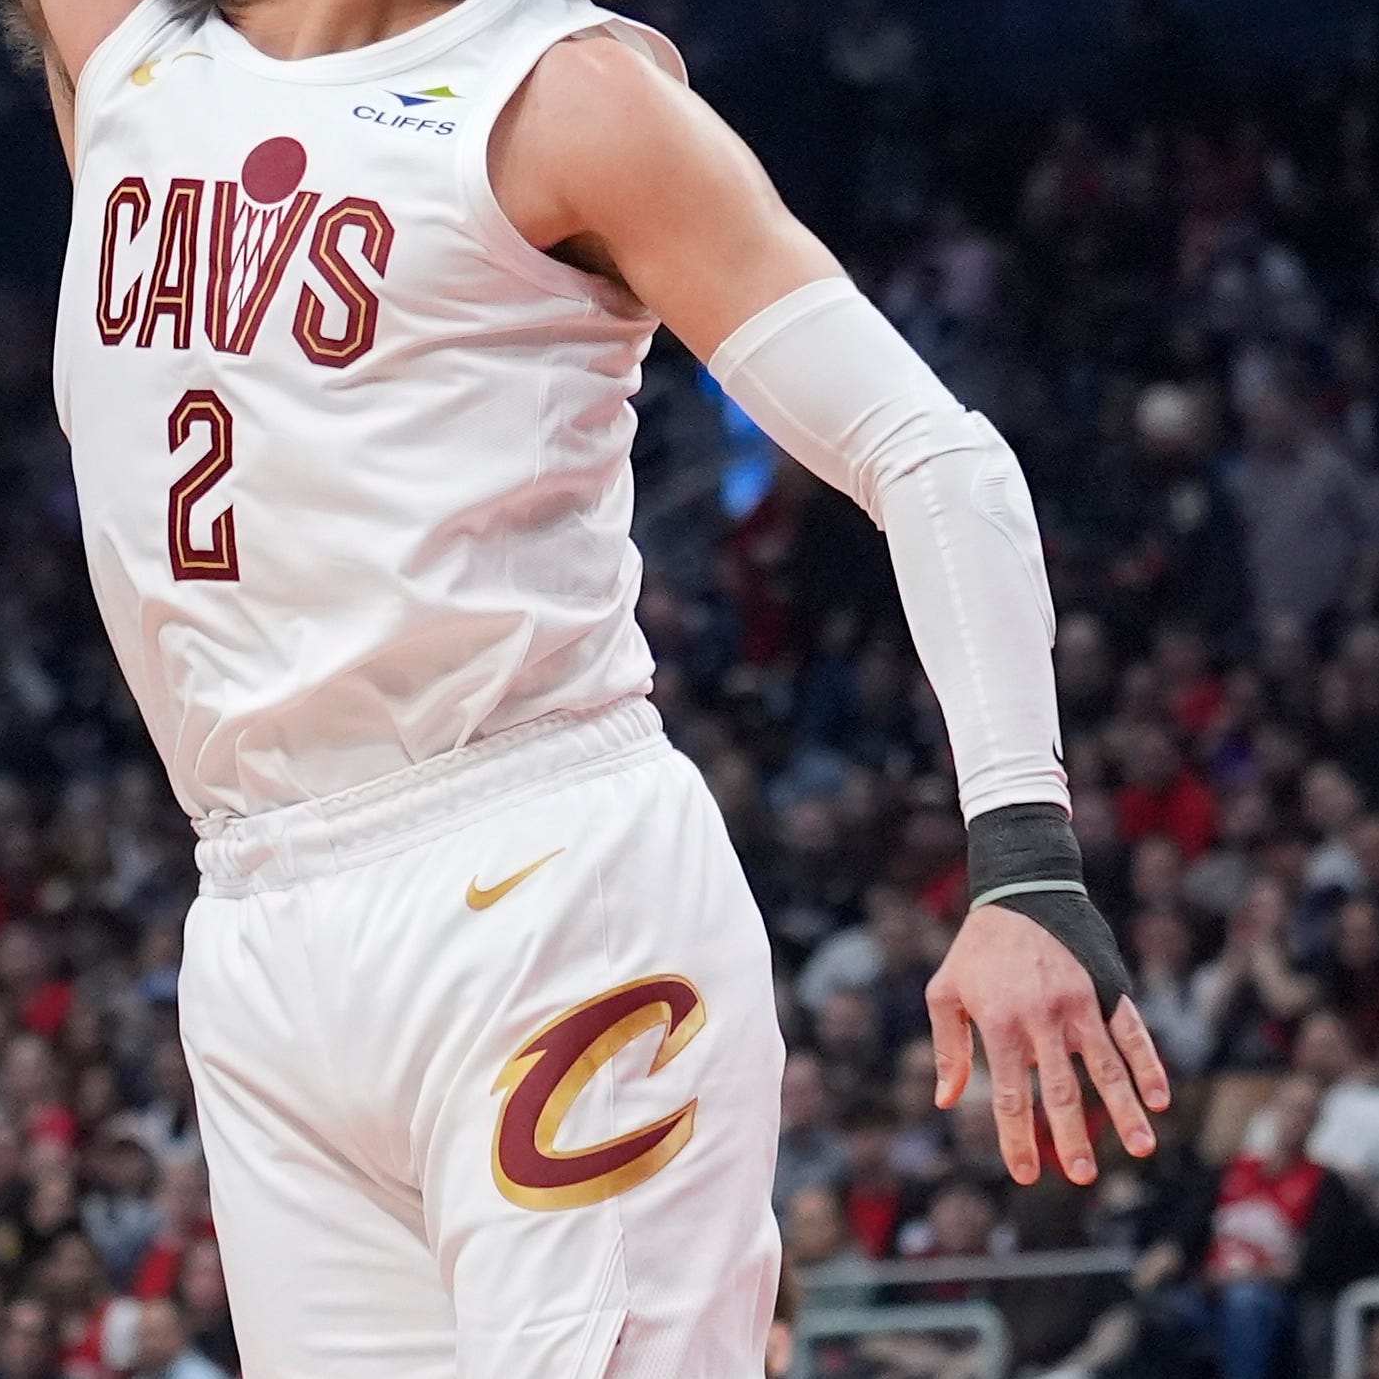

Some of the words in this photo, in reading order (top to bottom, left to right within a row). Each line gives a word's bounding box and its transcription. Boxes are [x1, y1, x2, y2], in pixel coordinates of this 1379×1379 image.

[353, 105, 456, 136] CLIFFS
[96, 176, 396, 369] CAVS
[168, 389, 241, 582] 2
